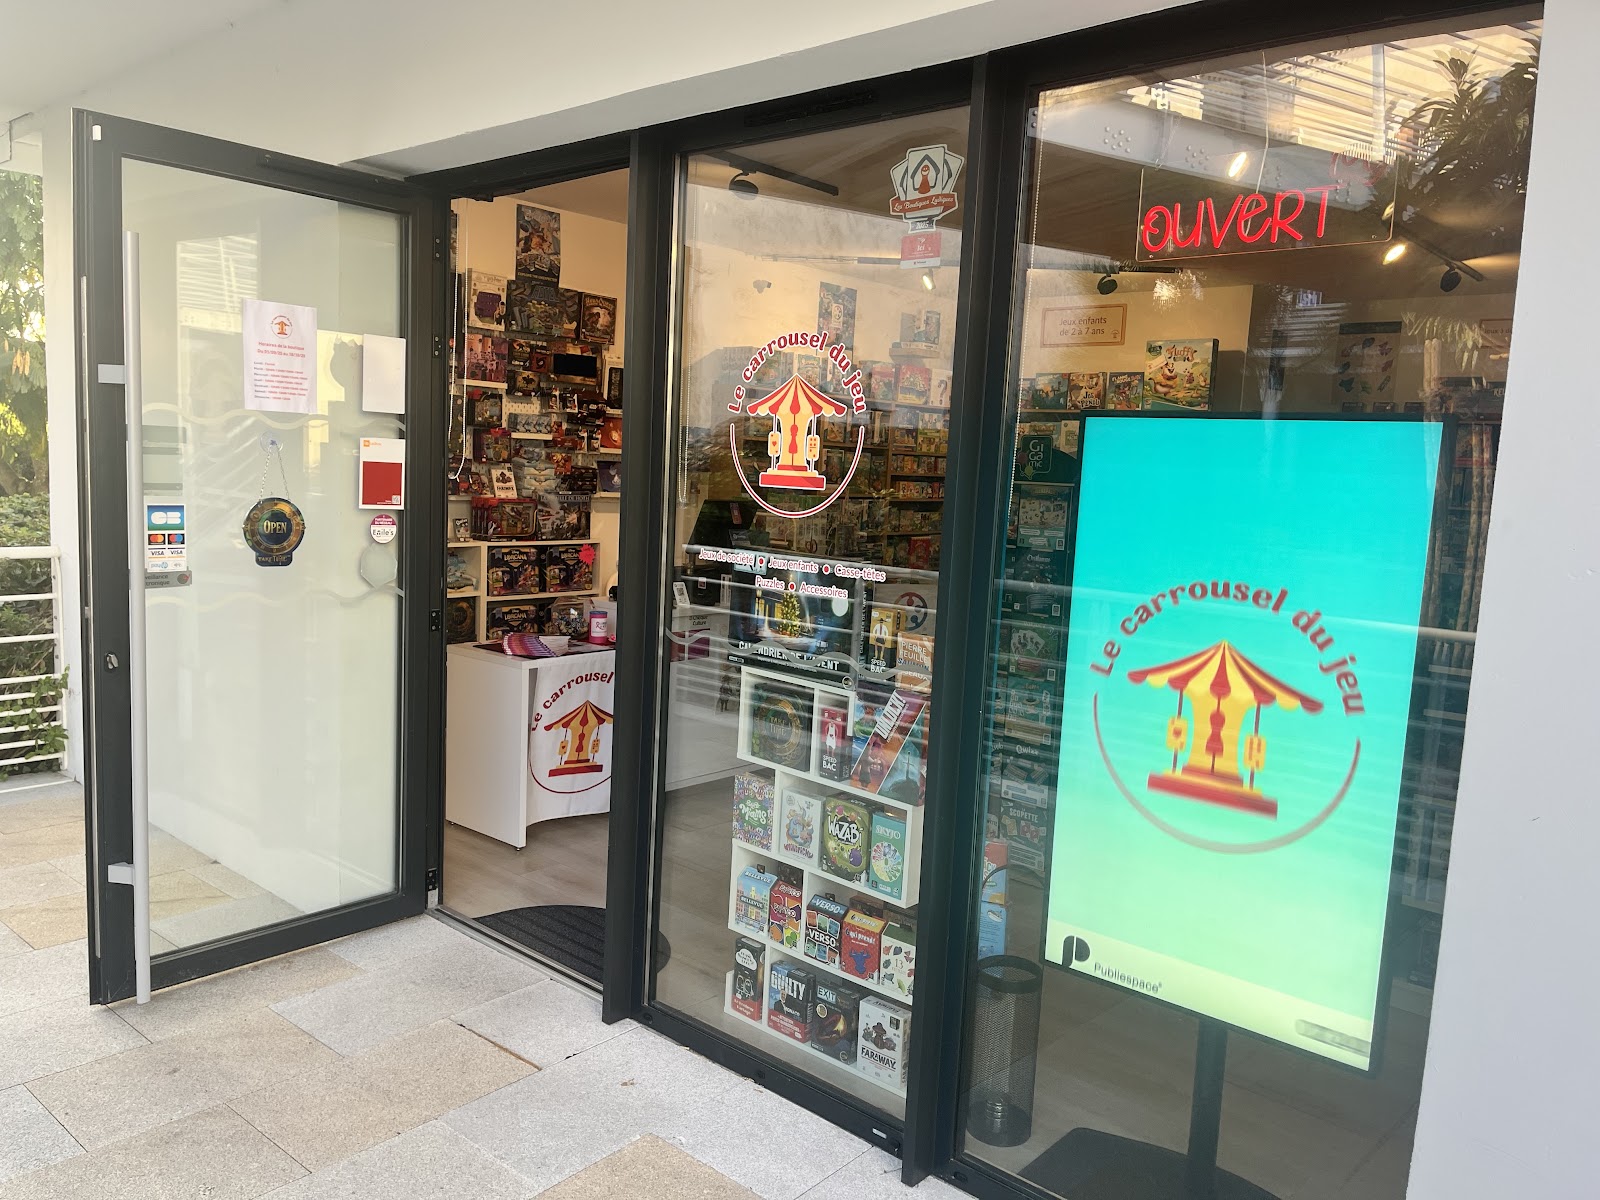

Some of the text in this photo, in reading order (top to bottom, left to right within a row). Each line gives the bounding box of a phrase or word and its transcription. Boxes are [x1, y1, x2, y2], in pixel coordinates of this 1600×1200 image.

[1143, 184, 1341, 252] OUVERT
[1059, 316, 1107, 326] Jeux enfants
[1060, 327, 1070, 336] de
[1071, 327, 1076, 335] 2
[1077, 326, 1083, 336] à
[1085, 327, 1090, 335] 7
[728, 332, 867, 414] Le carrousel du jeu
[699, 549, 886, 582] Jeux de société Jeux enfants Casse-têtes
[755, 576, 848, 598] Puzzles Accessoires
[1090, 579, 1366, 716] Le carrousel du jeu
[543, 671, 615, 709] carrousel
[822, 761, 837, 771] BAC
[1009, 807, 1039, 824] SCOPETTE
[740, 896, 763, 909] BELLEVUE
[815, 898, 841, 915] VERSO
[808, 928, 837, 948] VERSO
[770, 970, 806, 1001] GUILTY
[818, 987, 836, 1003] EXIT
[861, 1046, 897, 1070] FARAWAY
